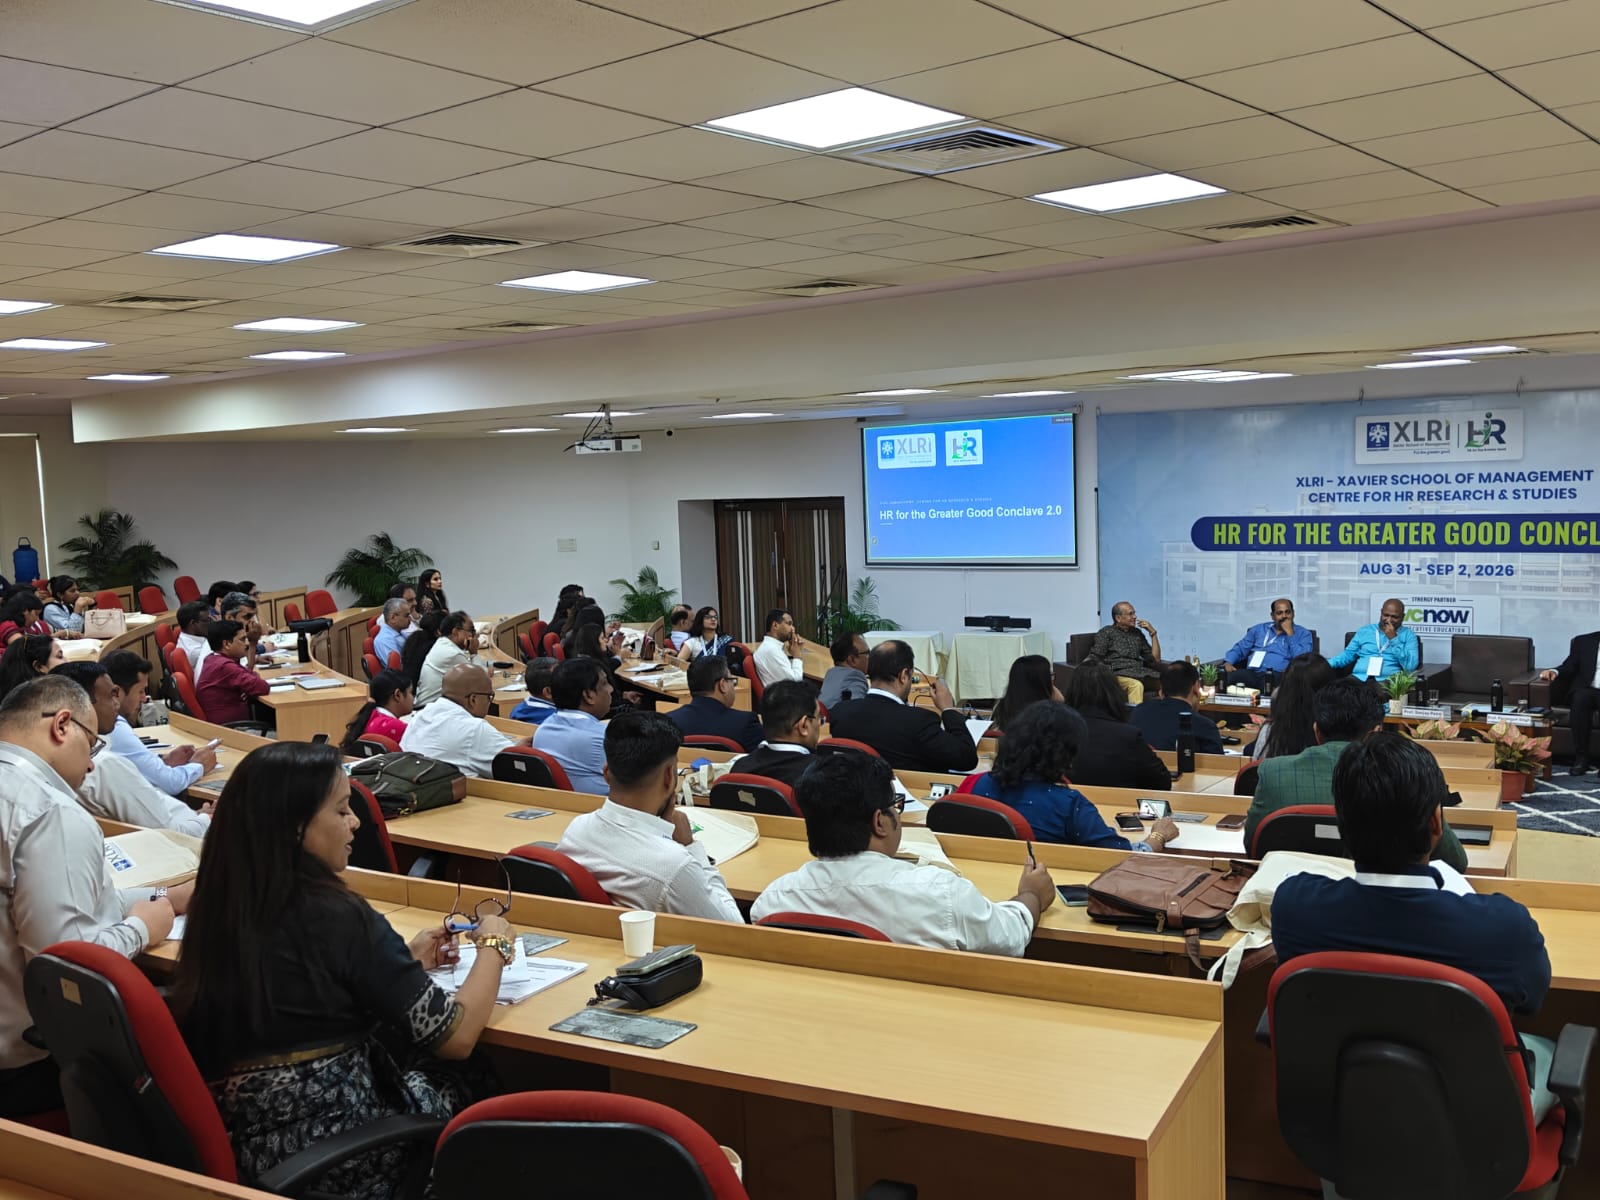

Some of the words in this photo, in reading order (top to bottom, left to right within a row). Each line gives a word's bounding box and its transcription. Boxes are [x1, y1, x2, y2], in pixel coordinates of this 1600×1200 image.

[1296, 476, 1325, 488] XLRI
[1337, 475, 1388, 487] XAVIER
[1391, 473, 1452, 486] SCHOOL
[1455, 472, 1475, 485] OF
[1478, 469, 1595, 484] MANAGEMENT
[1308, 491, 1361, 503] CENTRE
[1363, 491, 1391, 503] FOR
[1394, 490, 1414, 502] HR
[1417, 489, 1495, 502] RESEARCH
[1498, 488, 1509, 501] &
[1512, 487, 1578, 500] STUDIES
[880, 510, 893, 520] HR
[896, 509, 909, 520] for
[911, 509, 926, 519] the
[928, 508, 964, 519] Greater
[966, 507, 994, 518] Good
[996, 505, 1044, 517] Conclave
[1046, 505, 1062, 516] 2.0
[1213, 523, 1241, 545] HR
[1248, 523, 1287, 545] FOR
[1294, 522, 1332, 545] THE
[1338, 522, 1436, 545] GREATER
[1444, 521, 1511, 545] GOOD
[1360, 563, 1392, 575] AUG
[1396, 563, 1411, 575] 31
[1427, 564, 1454, 576] SEP
[1458, 564, 1471, 578] 2,
[1475, 564, 1515, 576] 2026
